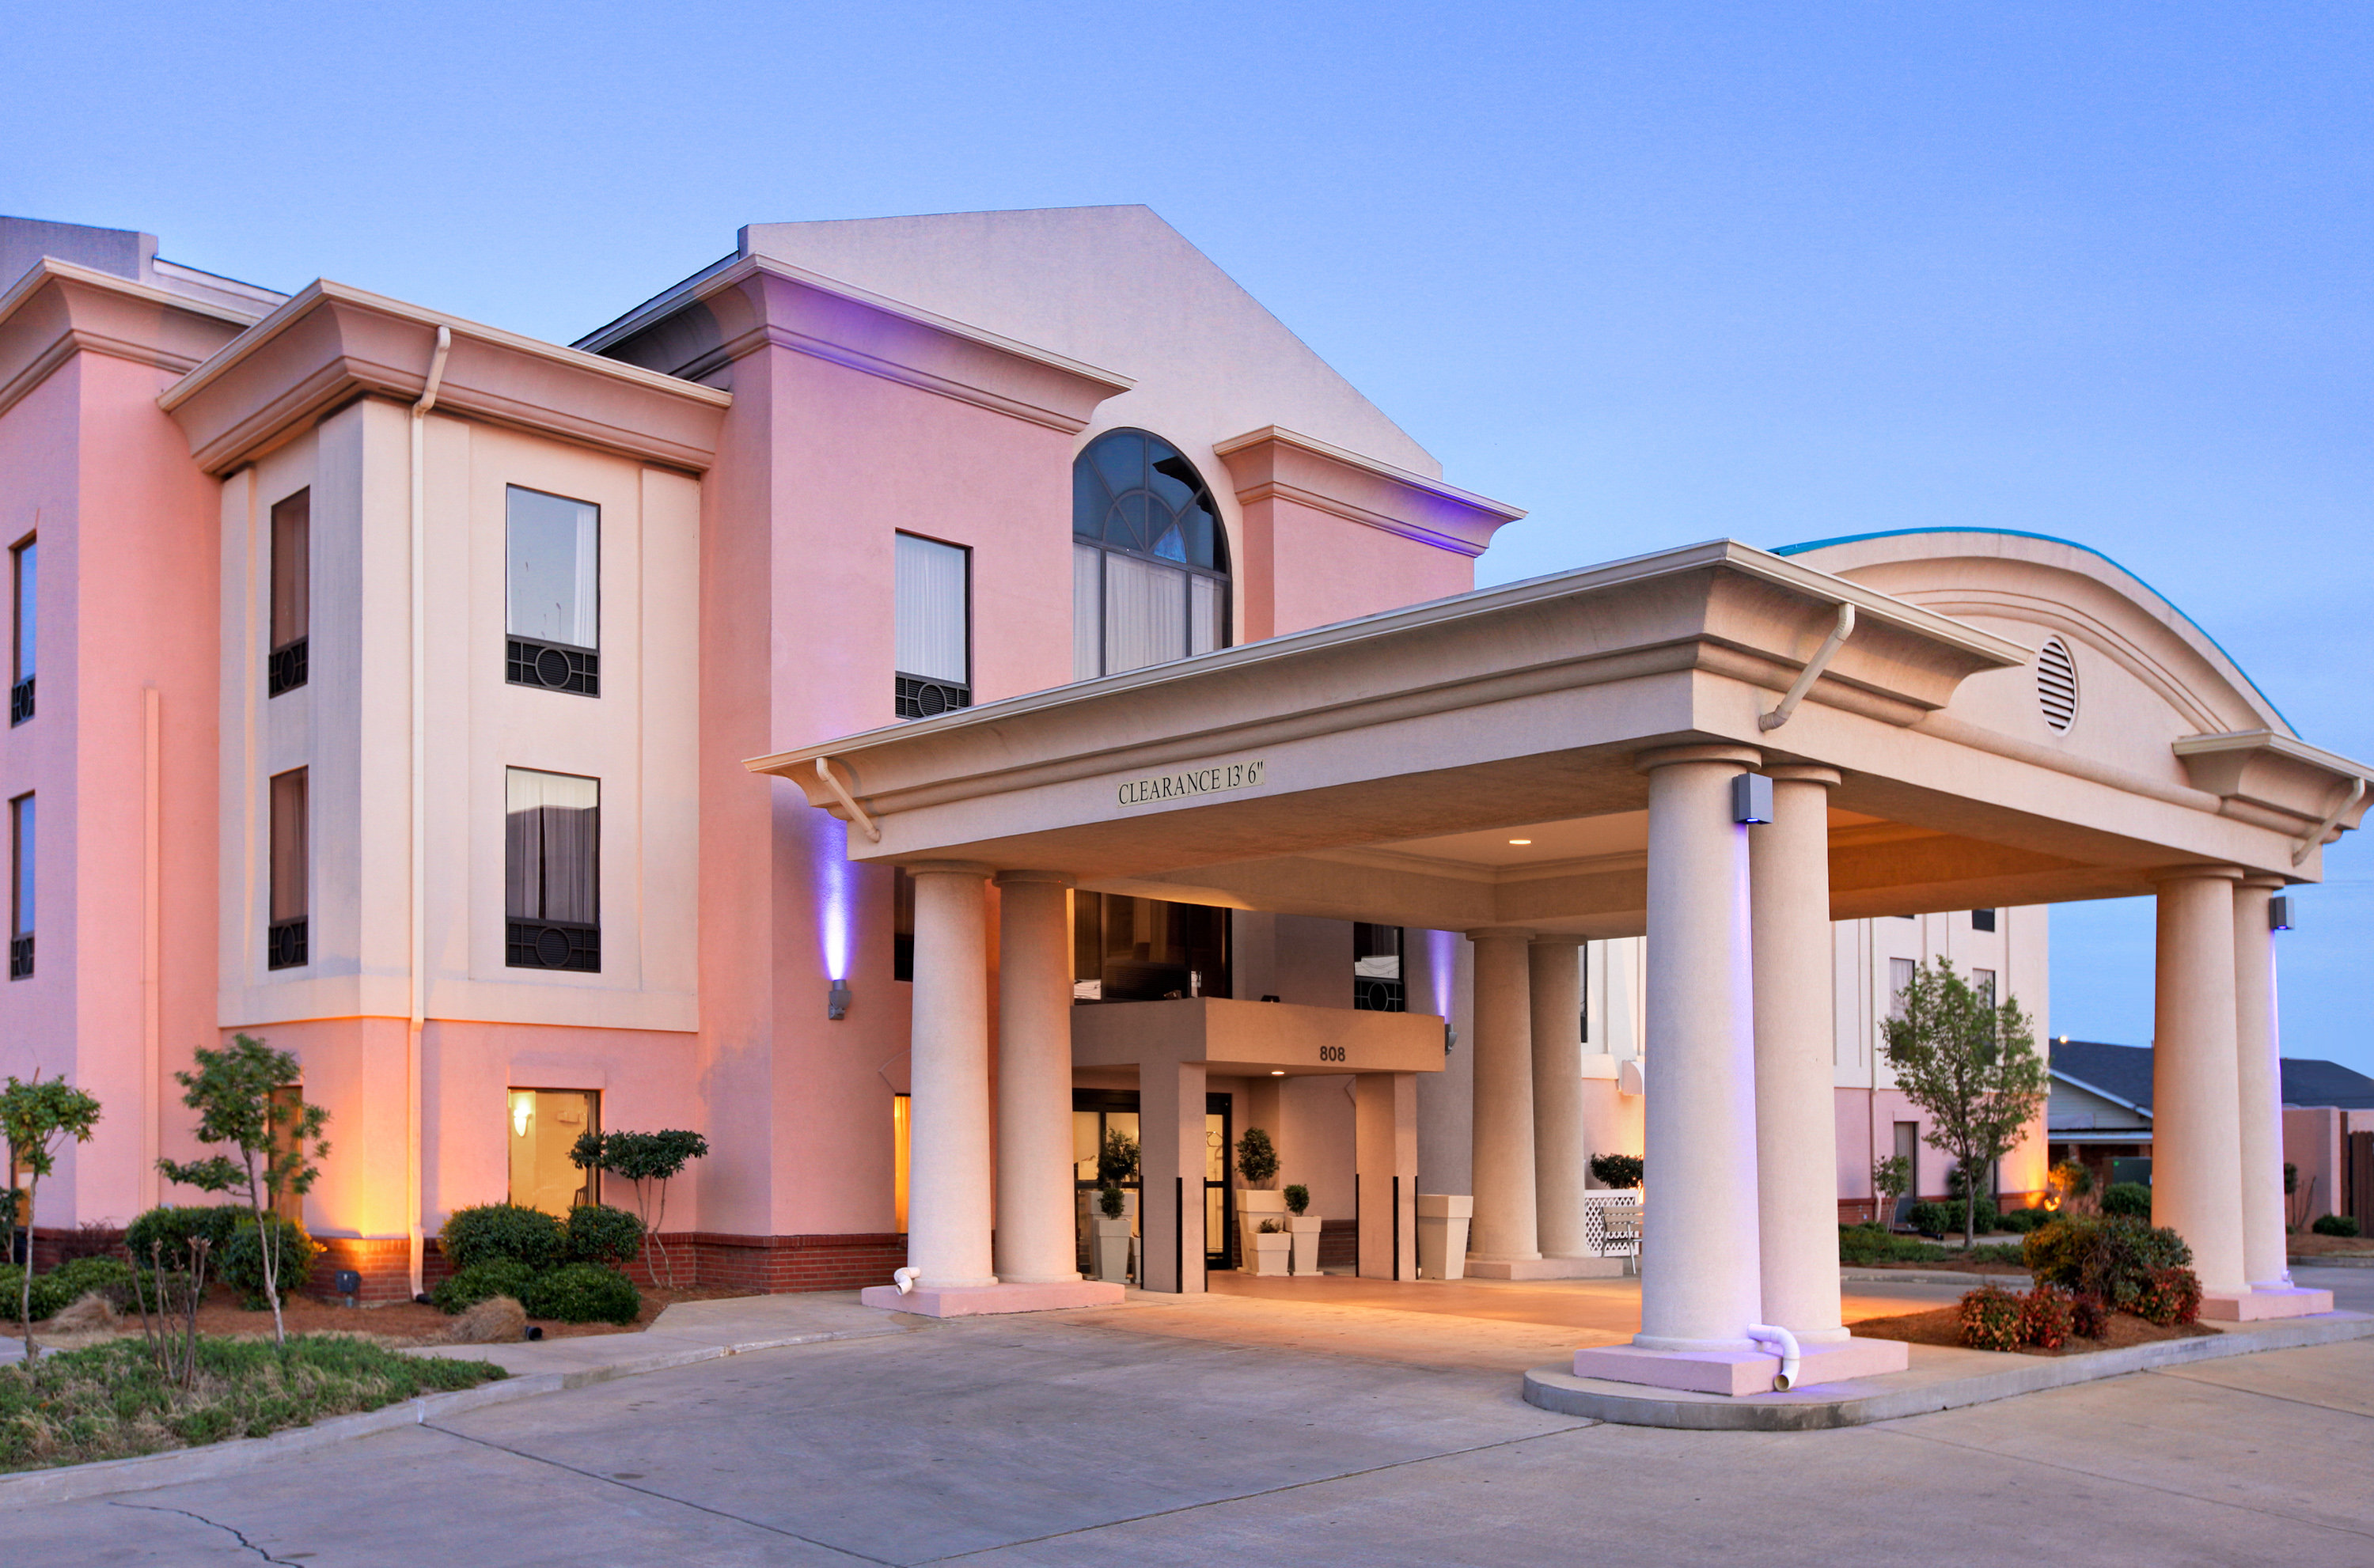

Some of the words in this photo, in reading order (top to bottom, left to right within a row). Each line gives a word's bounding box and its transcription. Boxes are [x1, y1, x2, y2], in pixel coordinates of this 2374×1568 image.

[1118, 768, 1221, 805] CLEARANCE
[1227, 764, 1243, 786] 13'
[1248, 760, 1264, 783] 6"
[1320, 1046, 1345, 1062] 808
